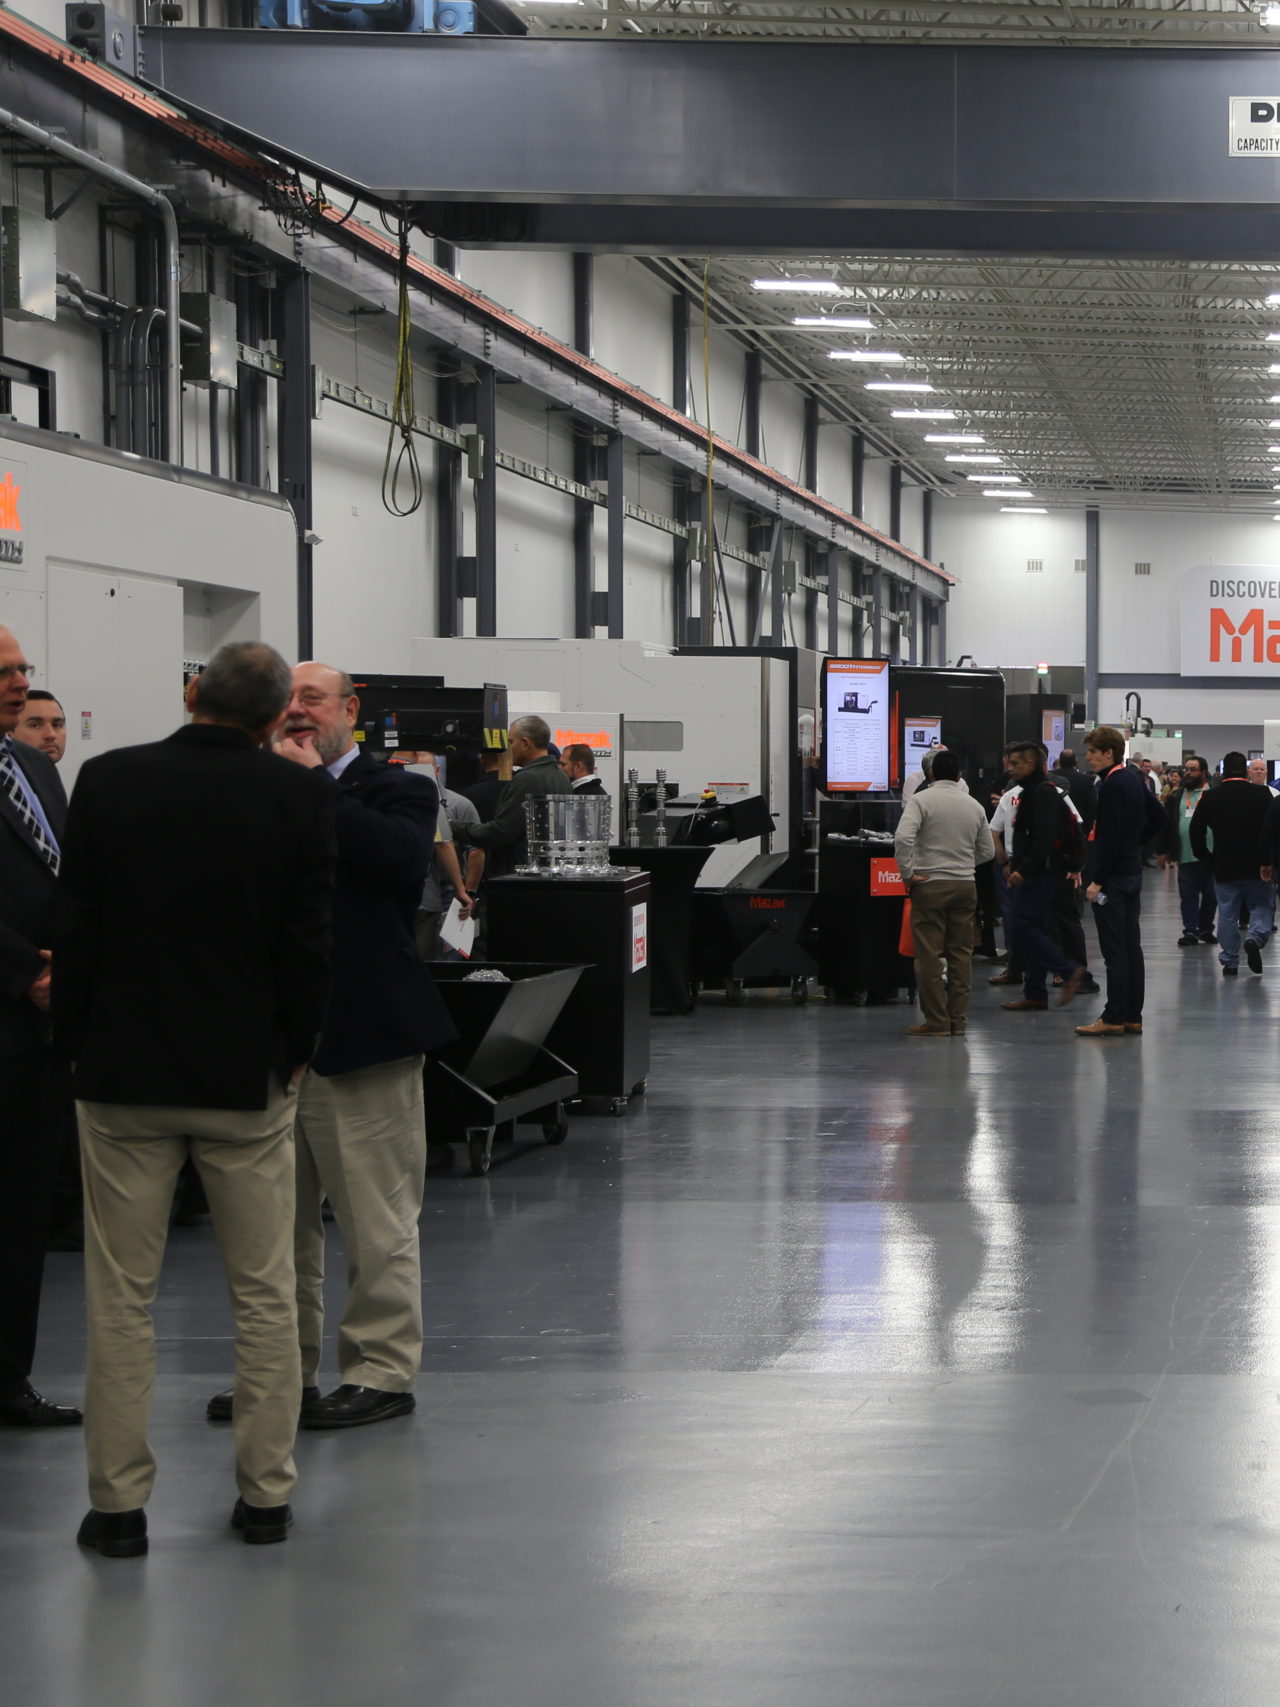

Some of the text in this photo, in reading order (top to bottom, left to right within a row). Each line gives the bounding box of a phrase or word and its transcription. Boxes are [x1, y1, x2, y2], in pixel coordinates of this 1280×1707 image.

[1237, 138, 1280, 152] CAPACITY
[555, 728, 612, 748] Mazak
[878, 870, 903, 883] Maz
[749, 896, 787, 909] Mazak
